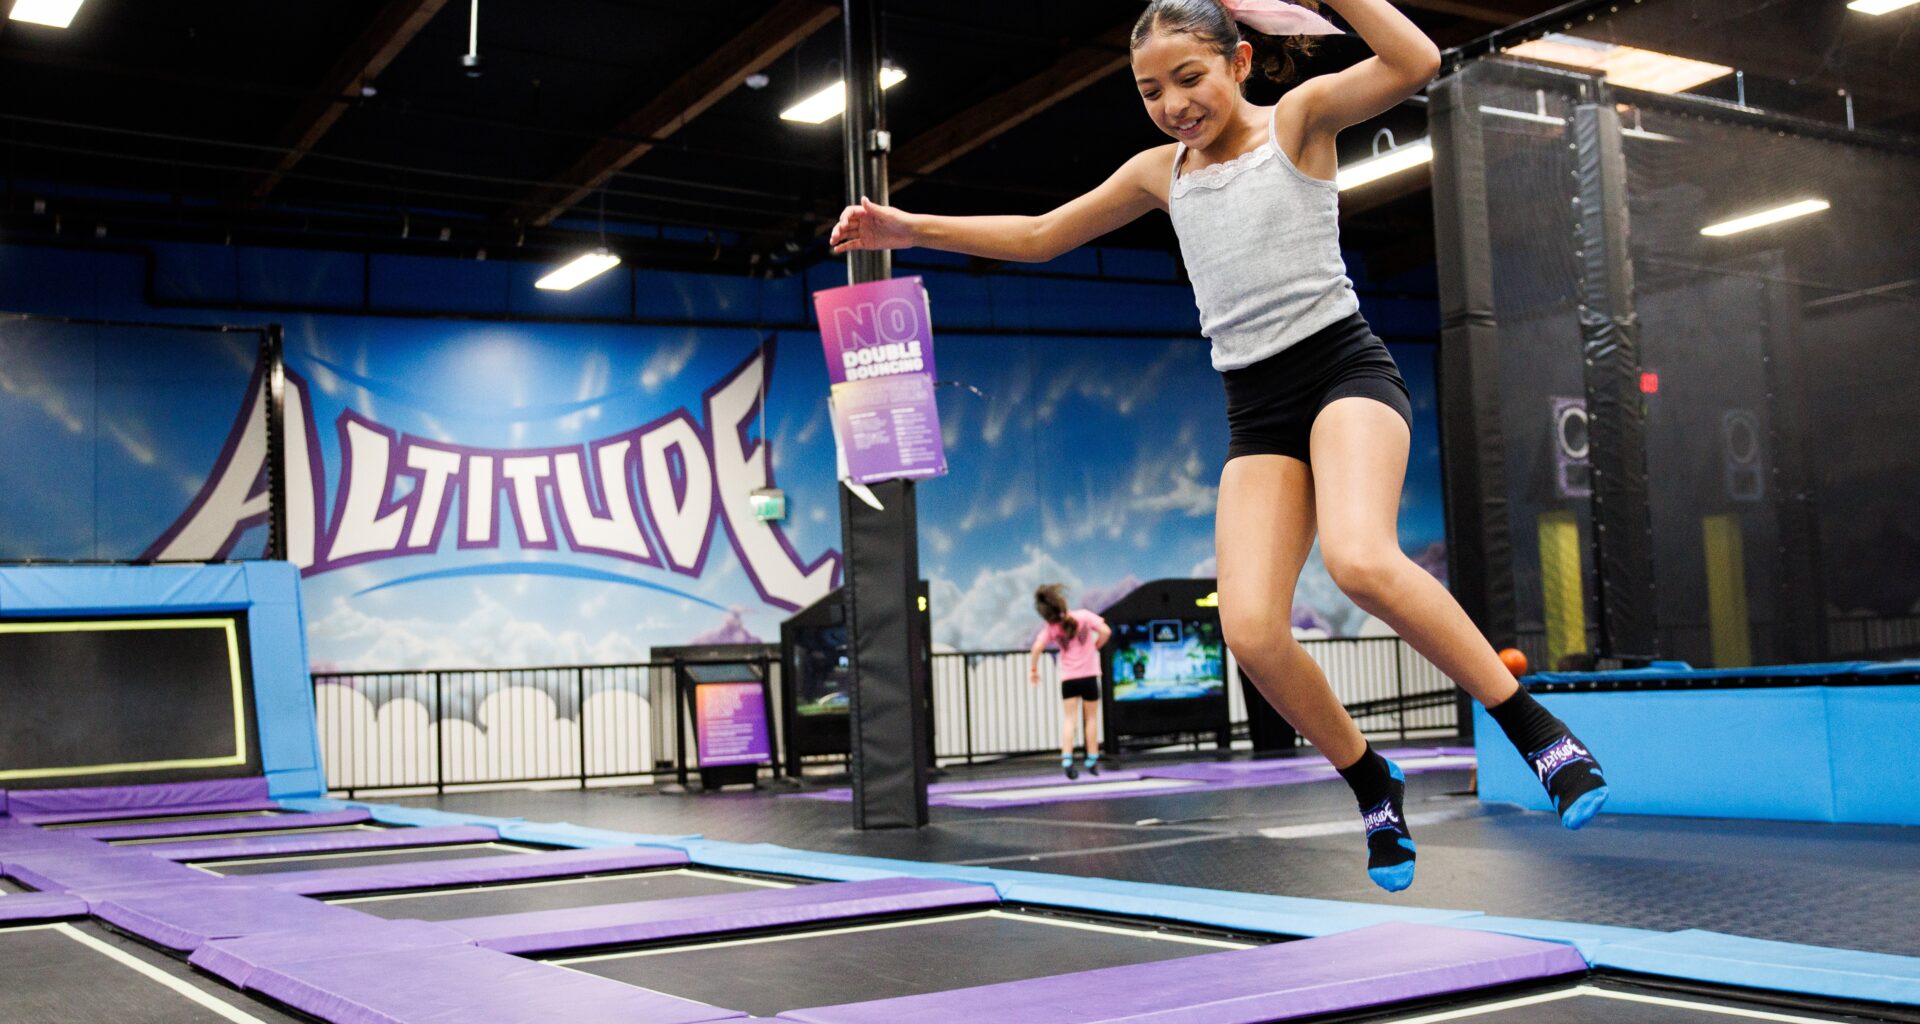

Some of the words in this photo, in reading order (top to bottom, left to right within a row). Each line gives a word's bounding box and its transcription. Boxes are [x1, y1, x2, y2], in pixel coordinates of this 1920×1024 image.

[834, 298, 919, 351] NO
[842, 340, 922, 369] DOUBLE
[845, 357, 924, 382] BOUNCING
[141, 335, 842, 609] ALTITUDE
[1364, 802, 1399, 829] LTITUDE
